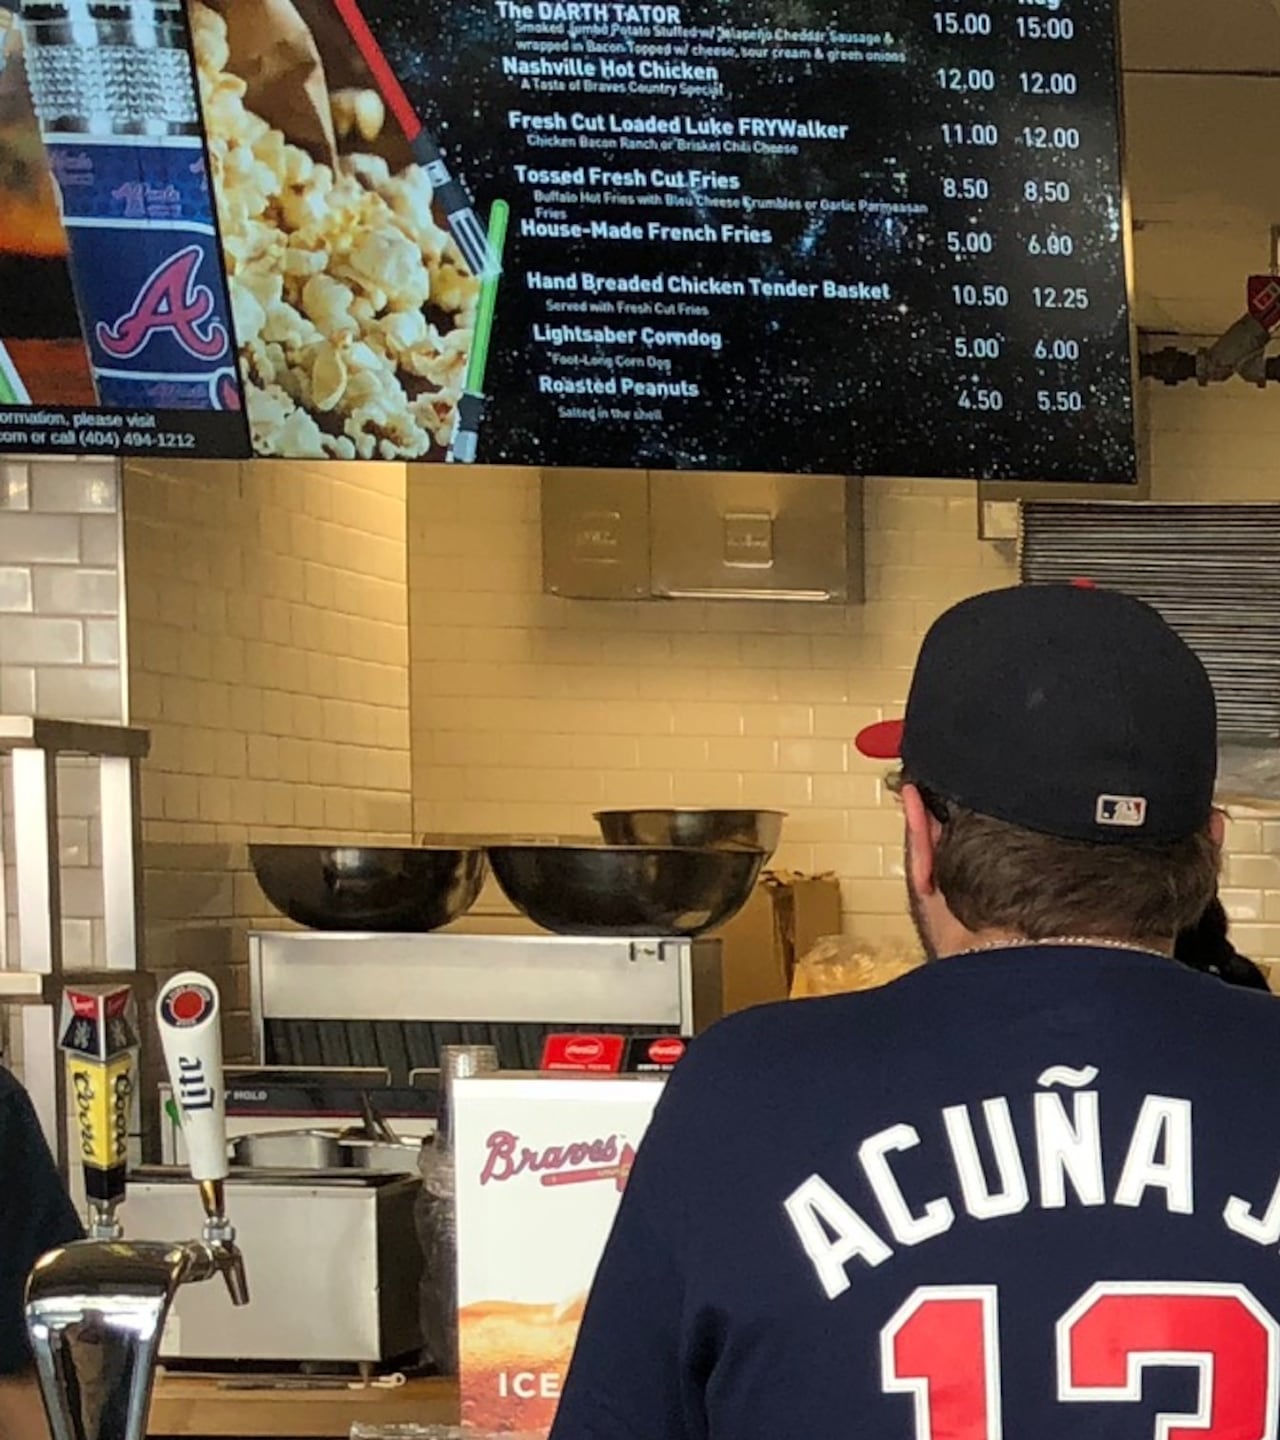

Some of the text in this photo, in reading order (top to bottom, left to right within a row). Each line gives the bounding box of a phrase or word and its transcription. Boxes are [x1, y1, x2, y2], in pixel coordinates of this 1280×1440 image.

[495, 2, 681, 24] The DARTH TATOR
[933, 12, 991, 34] 15.00
[515, 21, 564, 34] Smoked
[611, 23, 650, 37] Potato
[653, 25, 699, 37] Stuffed
[774, 28, 826, 41] Cheddar
[829, 30, 881, 46] Sausage
[516, 39, 569, 53] wrapped
[571, 40, 584, 51] in
[585, 40, 624, 52] Bacon
[627, 41, 671, 56] Topped
[772, 48, 810, 60] cream
[827, 48, 864, 63] green
[501, 56, 718, 80] Nashville Hot Chicken
[521, 78, 723, 96] A Taste of Braves Country Special
[936, 68, 1077, 95] 12.00 12.00
[508, 110, 849, 139] Fresh Cut Loaded Luke FRYWalker
[526, 134, 576, 147] Chicken
[579, 135, 617, 148] Bacon
[620, 137, 656, 150] Ranch
[677, 138, 721, 152] Brisket
[723, 140, 751, 153] Chili
[753, 141, 799, 155] Cheese
[941, 124, 1080, 150] 11.00 12.00
[514, 165, 740, 190] Tossed Fresh Cut Fries
[533, 190, 578, 203] Buffalo
[580, 191, 600, 204] Hot
[603, 192, 635, 204] Fries
[637, 193, 662, 205] with
[697, 195, 740, 208] Cheese
[742, 196, 802, 210] Crumbles
[804, 200, 817, 210] or
[820, 199, 856, 211] Garlic
[943, 178, 1070, 203] 8.50 8.50
[535, 207, 568, 220] Fries
[520, 218, 772, 244] House-Made French Fries
[947, 232, 1073, 256] 5.00 6.00
[526, 271, 891, 300] Hand Breaded Chicken Tender Basket
[952, 285, 1089, 309] 10.50 12.25
[546, 299, 709, 316] Served with Fresh Cut Fries
[533, 323, 722, 350] Lightsaber Corndog
[615, 355, 645, 367] Corn
[955, 337, 1079, 361] 5.00 6.00
[539, 375, 700, 397] Roasted Peanuts
[558, 405, 664, 420] Salted in the shell
[958, 389, 1082, 412] 4.50 5.50
[73, 414, 123, 429] please
[126, 413, 156, 428] visit
[31, 432, 45, 444] or
[50, 430, 76, 445] call
[79, 430, 120, 448] (404)
[123, 432, 196, 448] 494-1212
[178, 1056, 215, 1111] Lite
[480, 1130, 618, 1187] Braves
[784, 1065, 1195, 1299] ACUÑA
[500, 1372, 562, 1398] ICE
